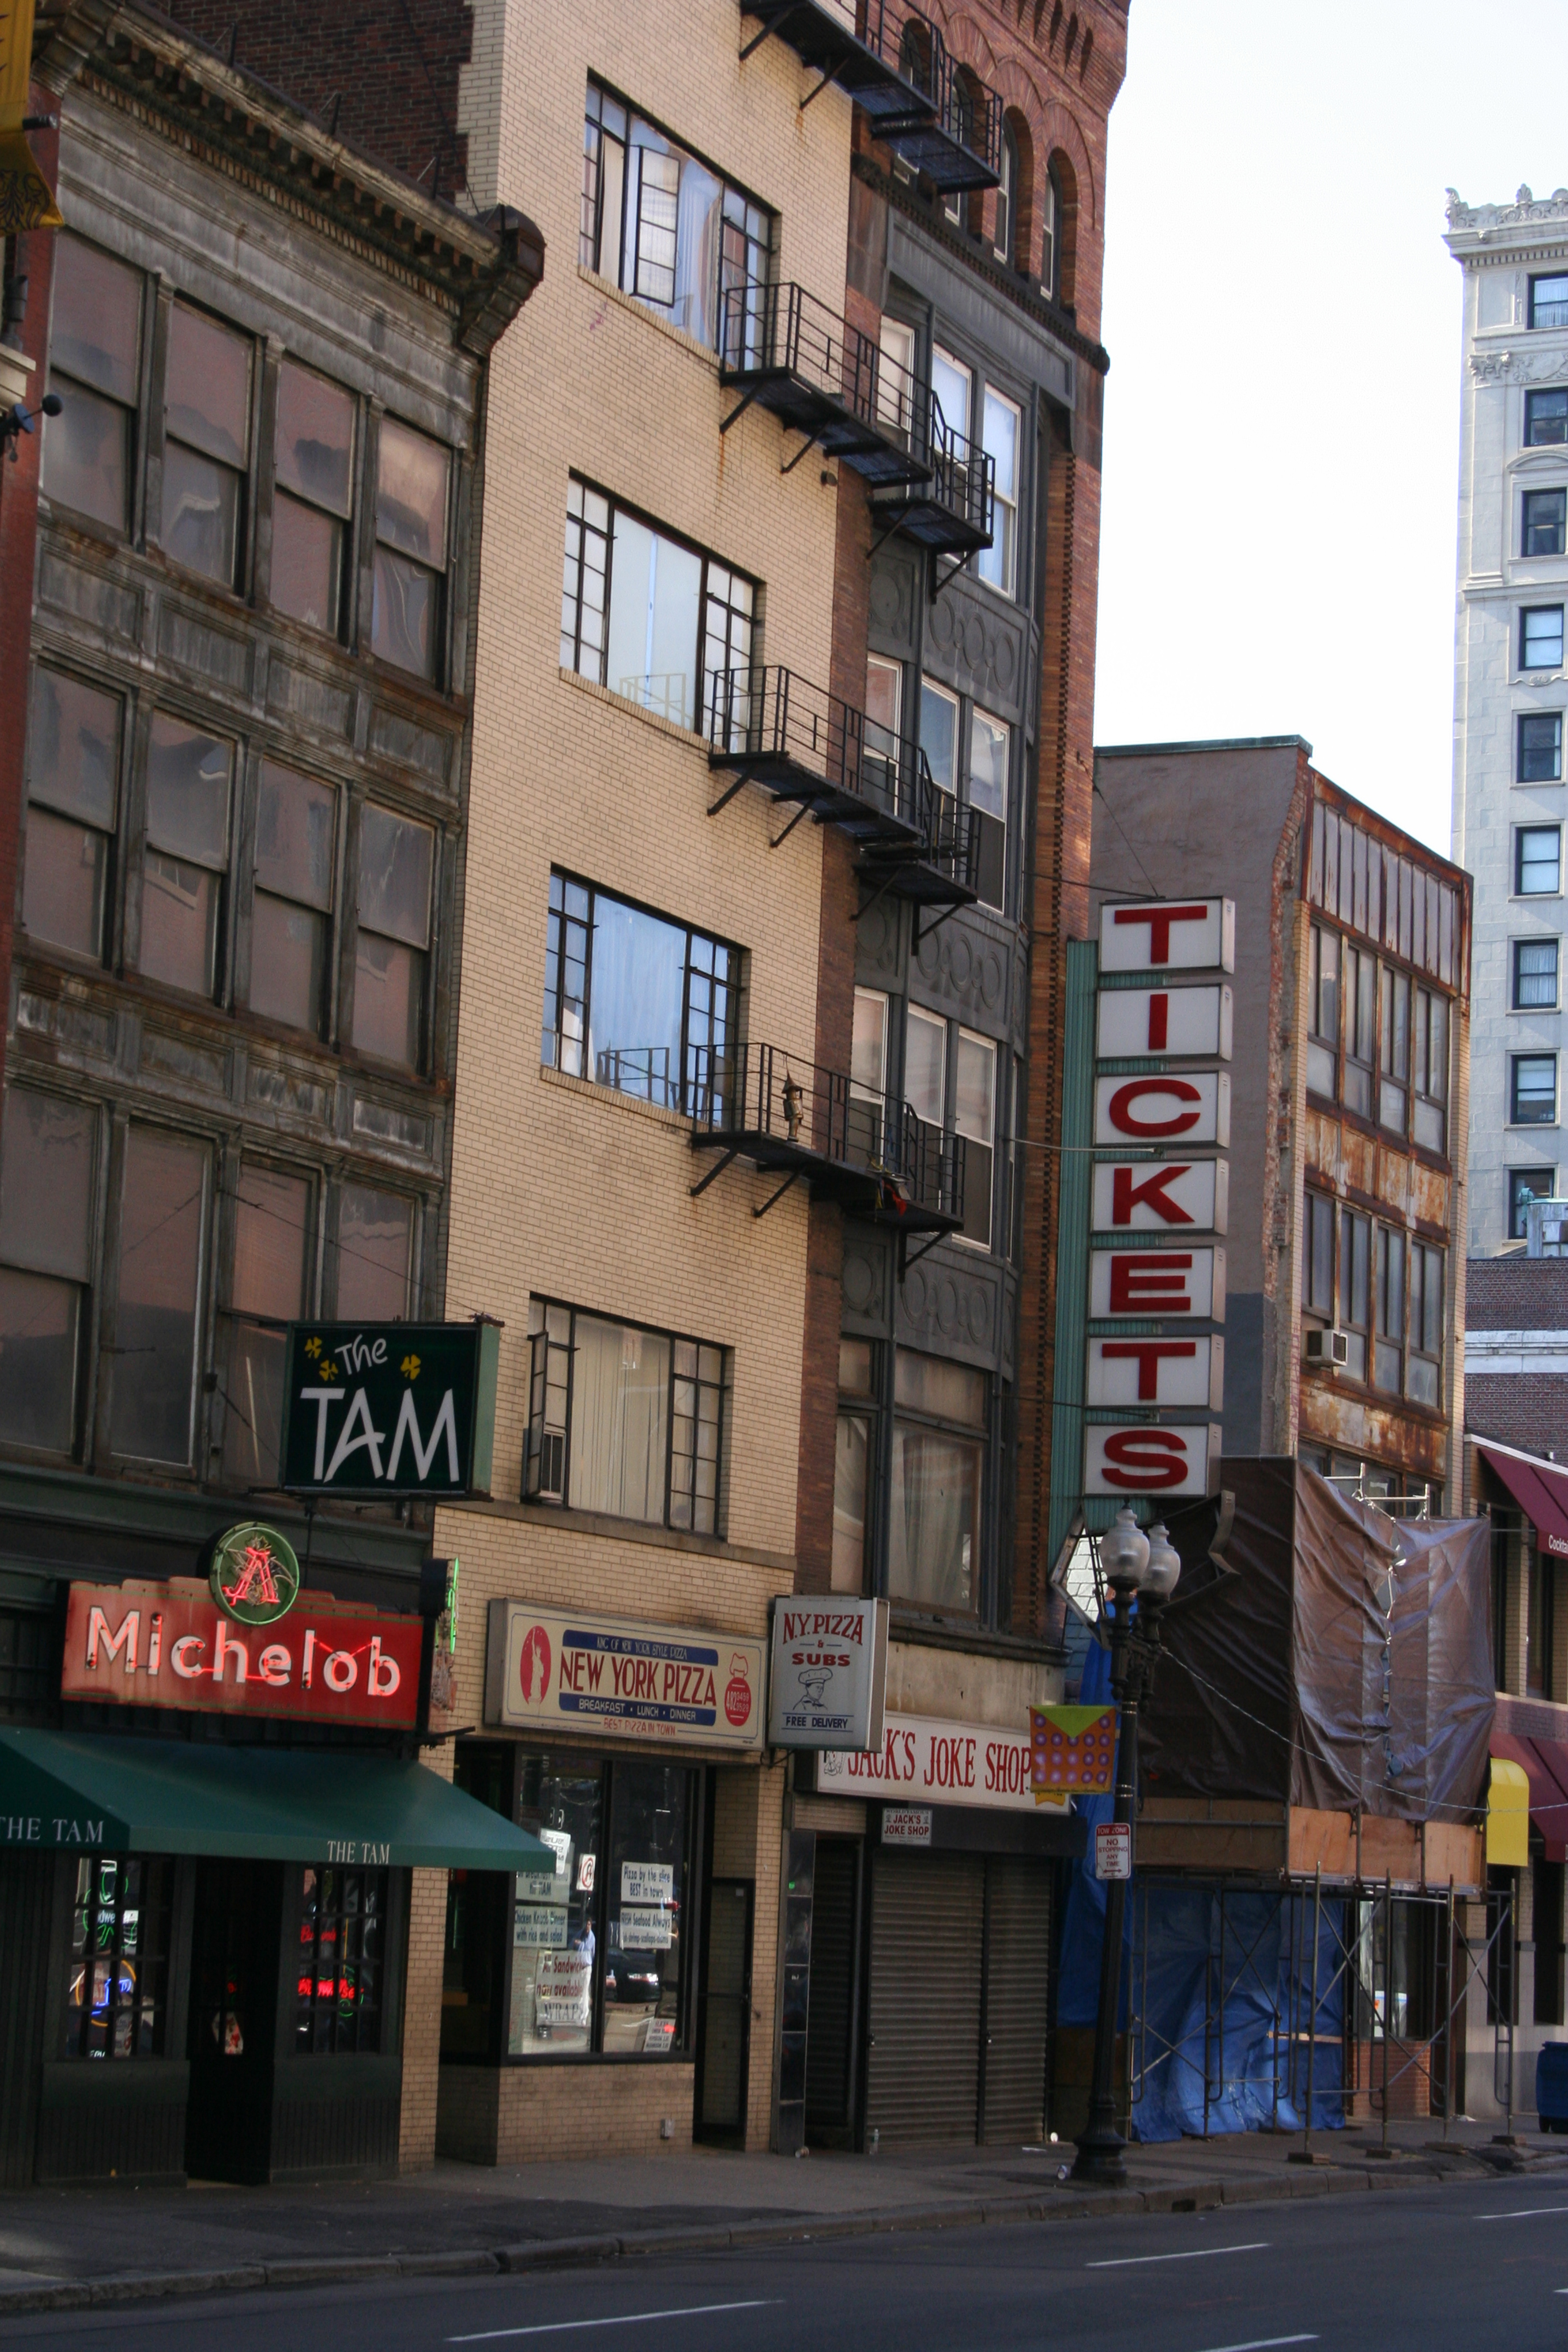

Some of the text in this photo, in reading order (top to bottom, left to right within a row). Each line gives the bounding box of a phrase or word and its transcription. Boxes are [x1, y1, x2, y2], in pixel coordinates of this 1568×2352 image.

[1101, 905, 1207, 1489] TICKETS
[335, 1334, 388, 1375] The
[300, 1387, 460, 1483] TAM
[812, 1614, 864, 1646] PIZZA
[86, 1606, 401, 1697] Michelob
[622, 1640, 632, 1652] NEW
[635, 1641, 650, 1655] YORK
[652, 1644, 668, 1658] STYLE
[670, 1646, 688, 1660] PIZZA
[818, 1639, 824, 1648] &
[792, 1653, 850, 1667] SUBS
[560, 1650, 716, 1706] NEW YORK PIZZA
[579, 1699, 696, 1722] BREAKFAST LUNCH DINNER
[603, 1717, 676, 1736] BEST PIZZA IN TOWN
[786, 1716, 848, 1729] FREE DELIVERY
[924, 1736, 976, 1788] JOKE
[985, 1742, 1031, 1796] SHOP
[893, 1814, 921, 1824] JACK'S
[52, 1819, 104, 1843] TAM
[884, 1825, 929, 1835] JOKE SHOP
[327, 1840, 390, 1864] THE TAM
[624, 1865, 671, 1883] Pizza by the slice
[630, 1882, 663, 1898] BEST in town
[633, 1913, 651, 1927] Seafood
[652, 1913, 671, 1931] Always
[517, 1926, 563, 1942] with rice and salad
